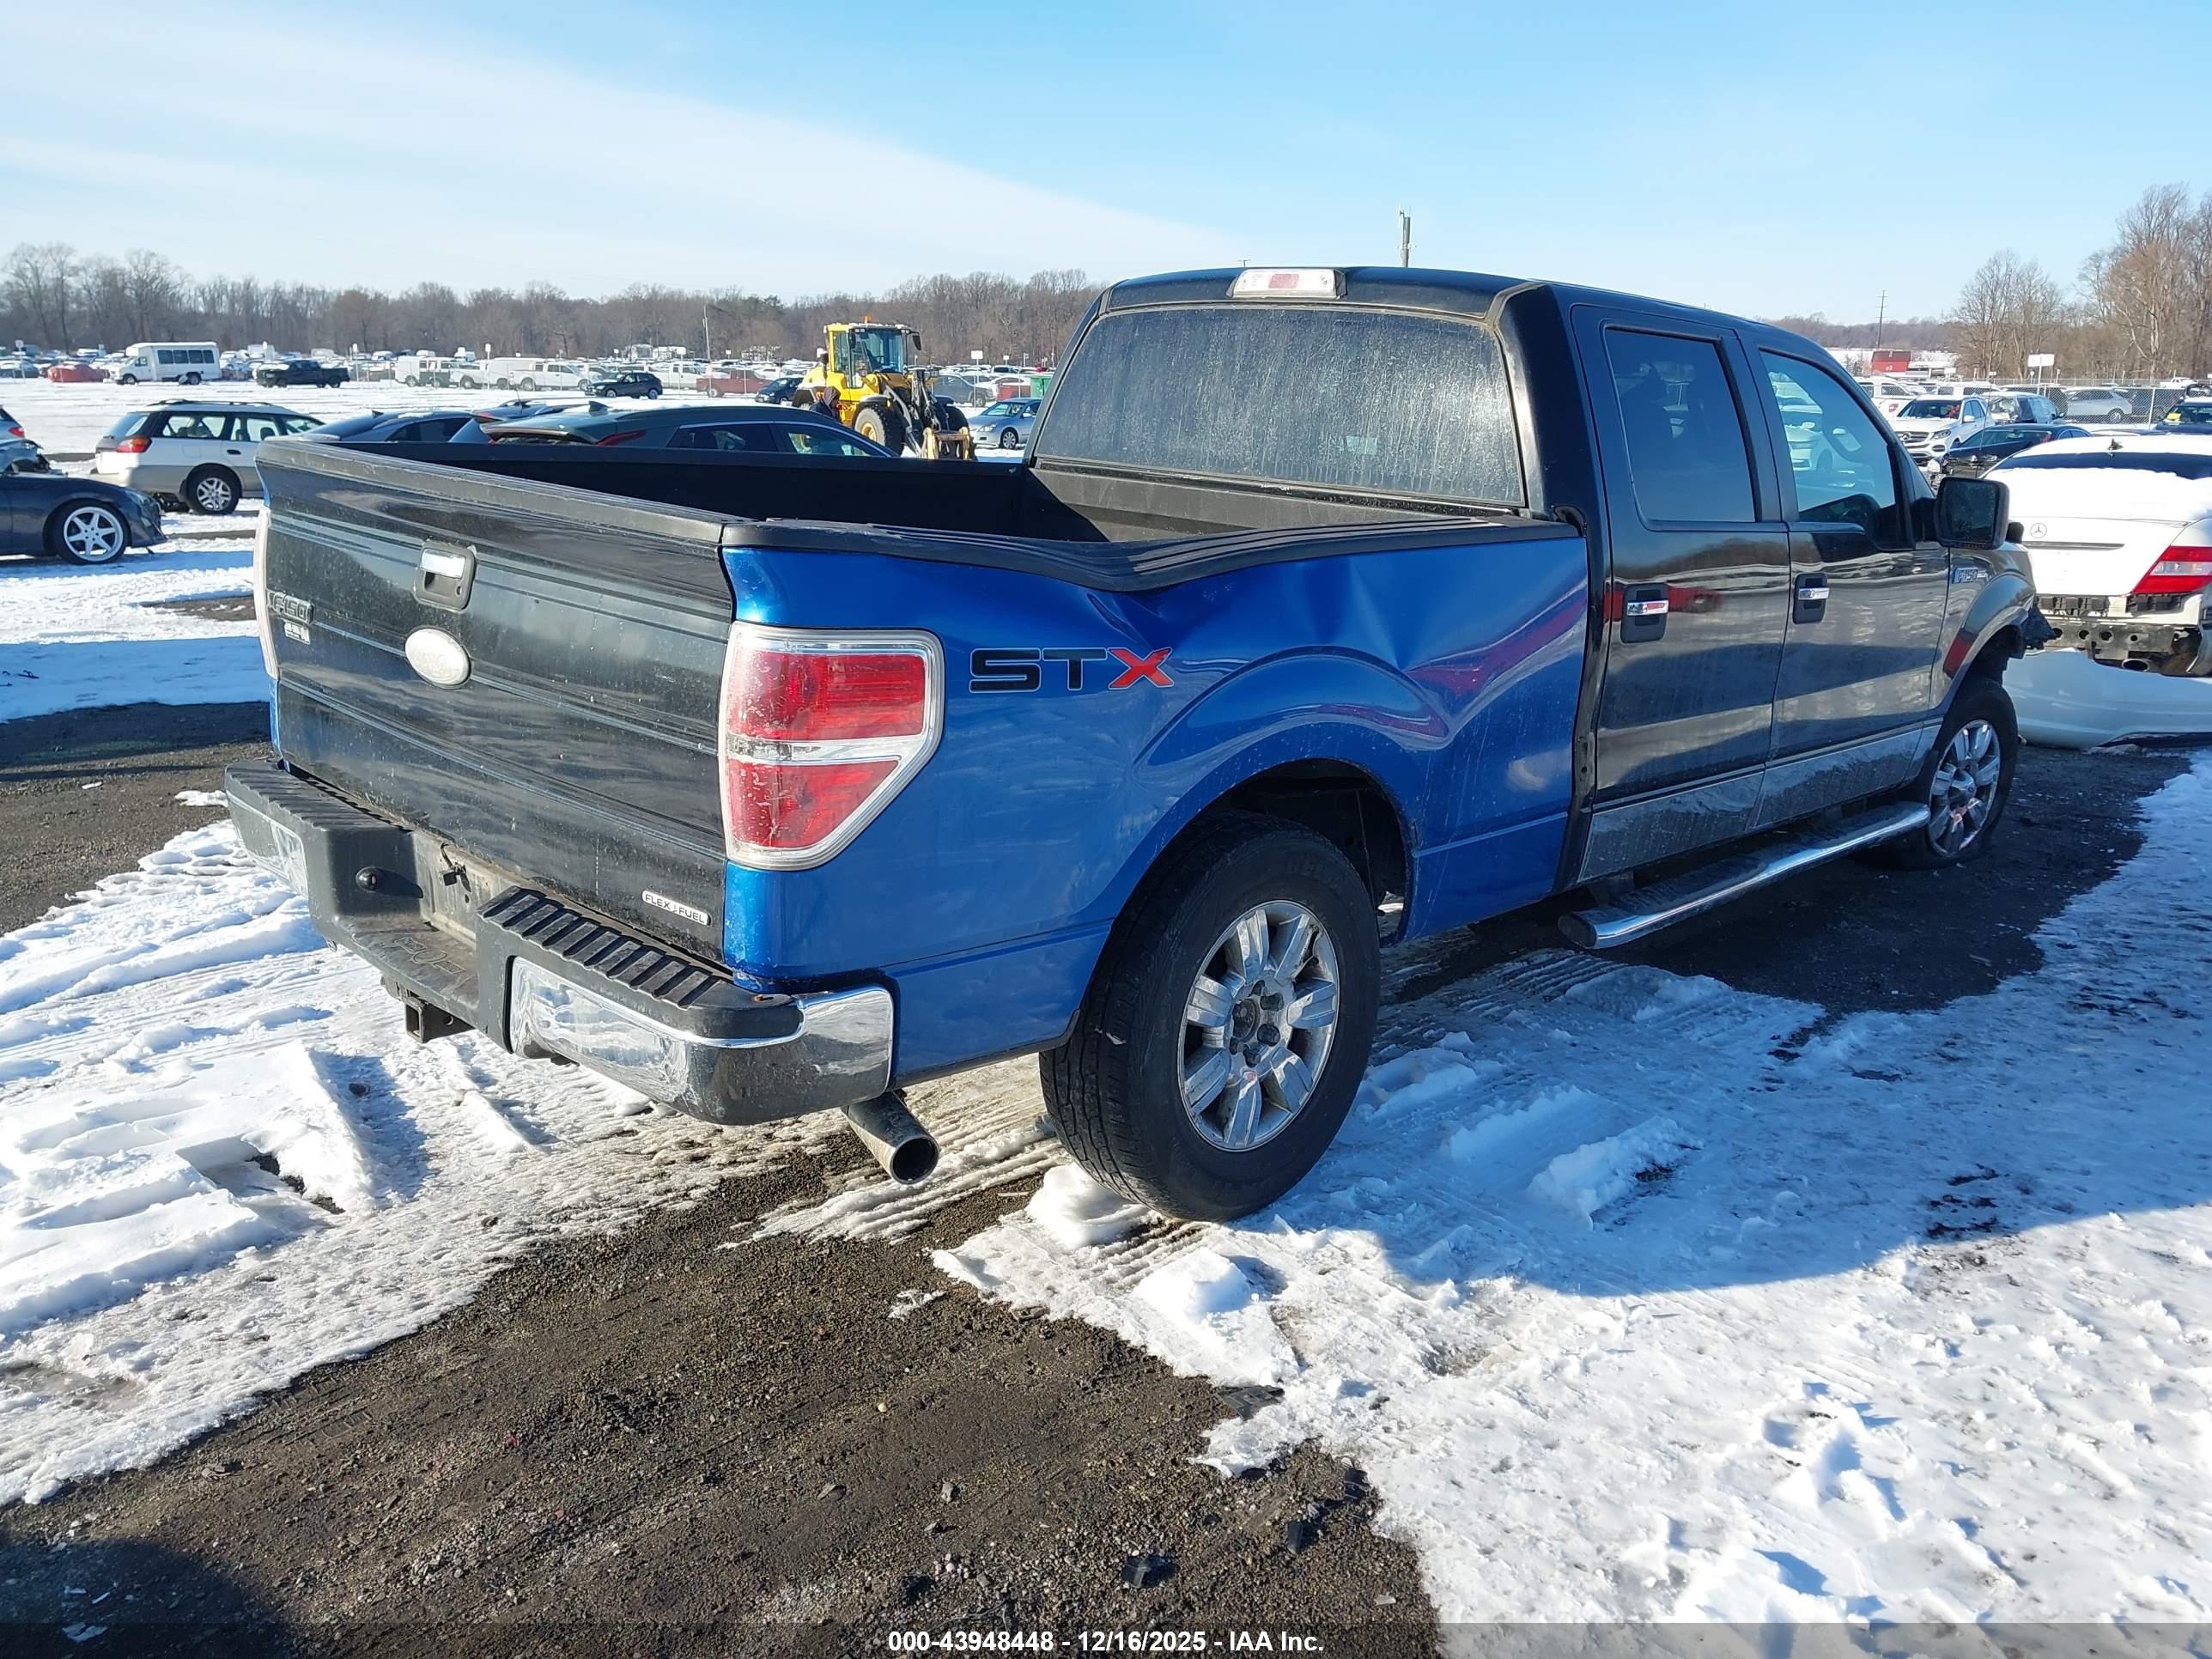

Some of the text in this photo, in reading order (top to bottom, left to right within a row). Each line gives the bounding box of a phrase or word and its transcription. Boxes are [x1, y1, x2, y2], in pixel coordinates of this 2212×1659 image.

[969, 647, 1175, 693] STX
[645, 893, 705, 924] FLEX FUEL
